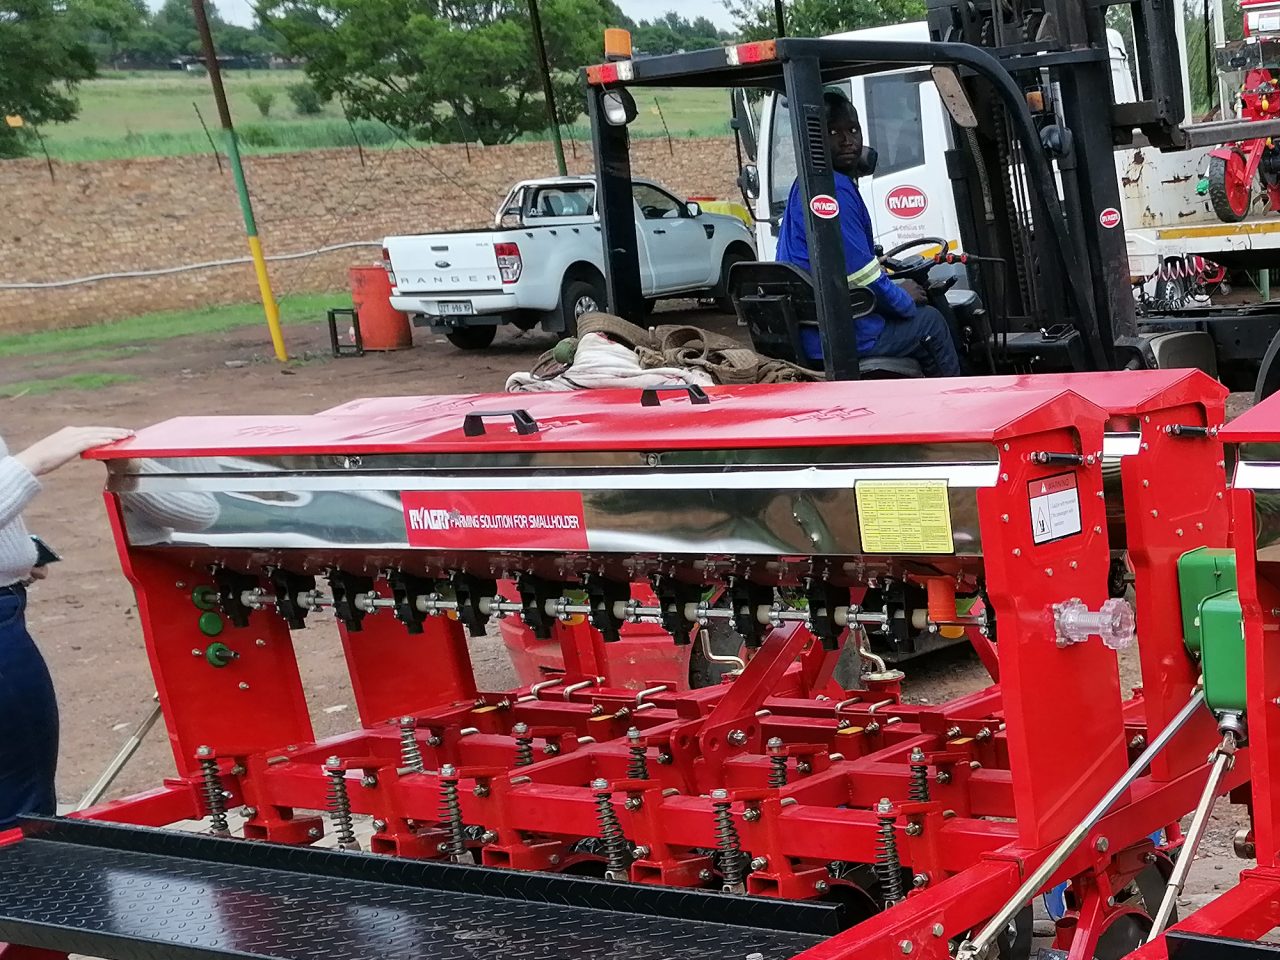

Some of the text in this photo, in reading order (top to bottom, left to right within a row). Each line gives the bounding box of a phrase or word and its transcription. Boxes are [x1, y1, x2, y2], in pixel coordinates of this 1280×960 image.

[814, 201, 836, 211] RYAGRI
[889, 194, 924, 209] RYAGRI
[400, 274, 497, 284] RANGER
[409, 507, 579, 530] RYAGRI FARMING SOLUTION FOR SMALLHOLDER
